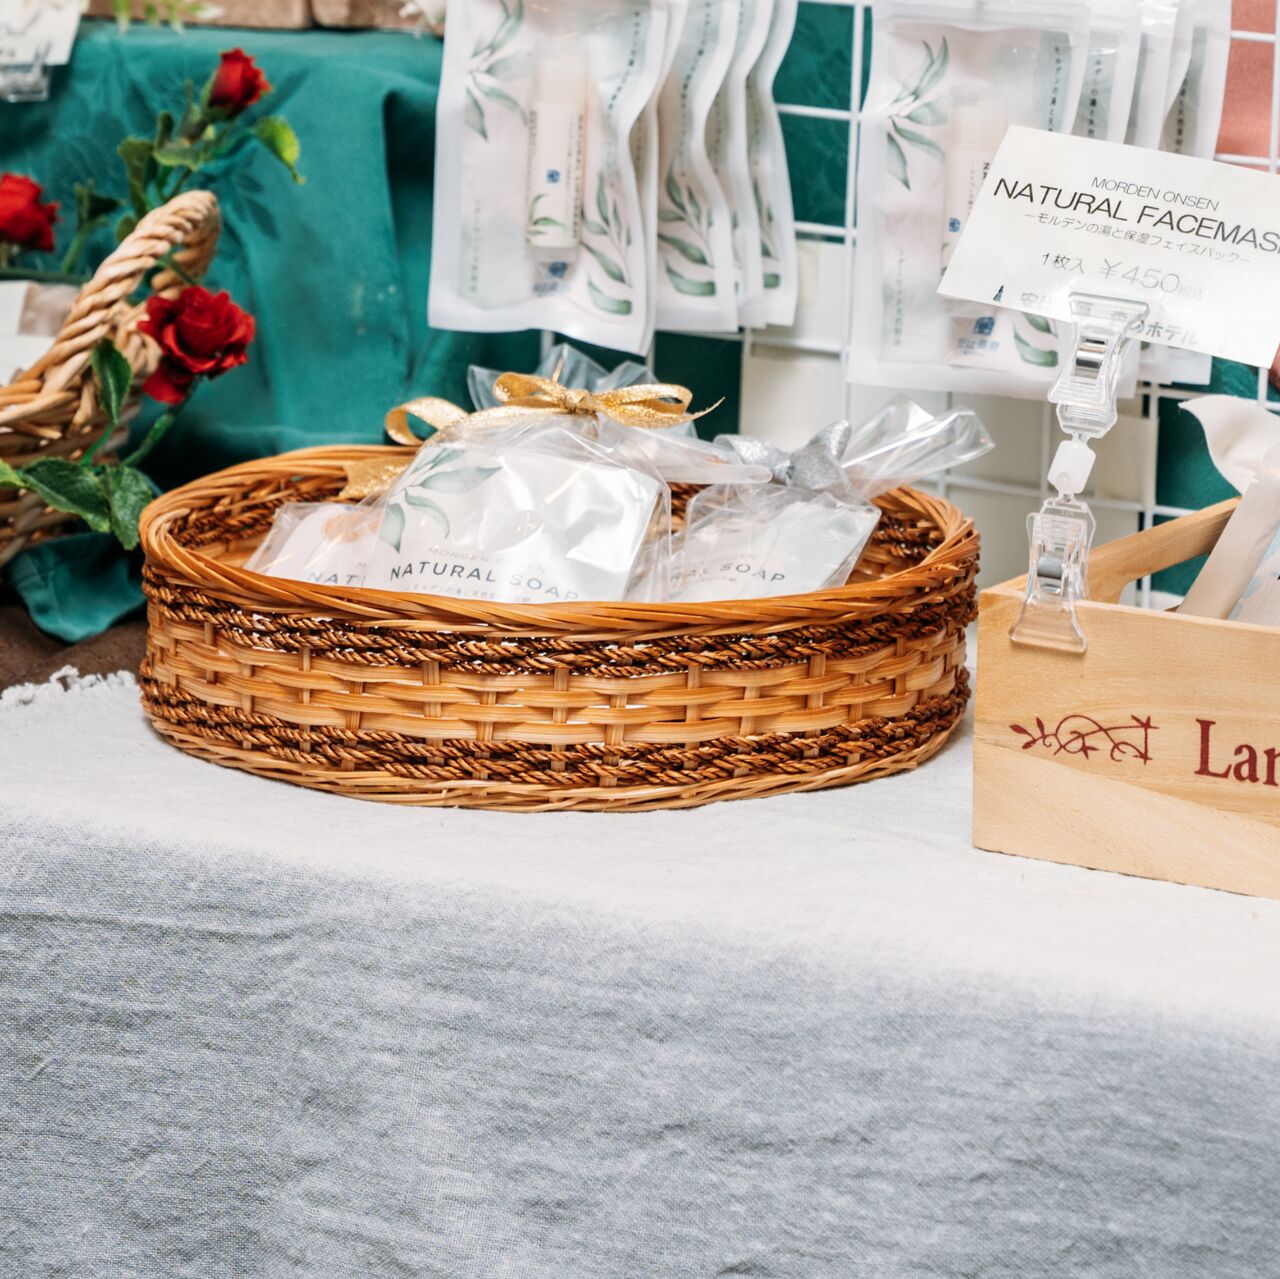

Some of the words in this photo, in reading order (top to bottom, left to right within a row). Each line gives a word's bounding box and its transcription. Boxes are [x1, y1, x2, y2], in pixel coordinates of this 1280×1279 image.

[993, 176, 1128, 223] NATURAL
[1091, 176, 1161, 200] MORDEN
[1162, 190, 1221, 213] ONSEN
[389, 560, 498, 584] NATURAL
[509, 573, 581, 601] SOAP
